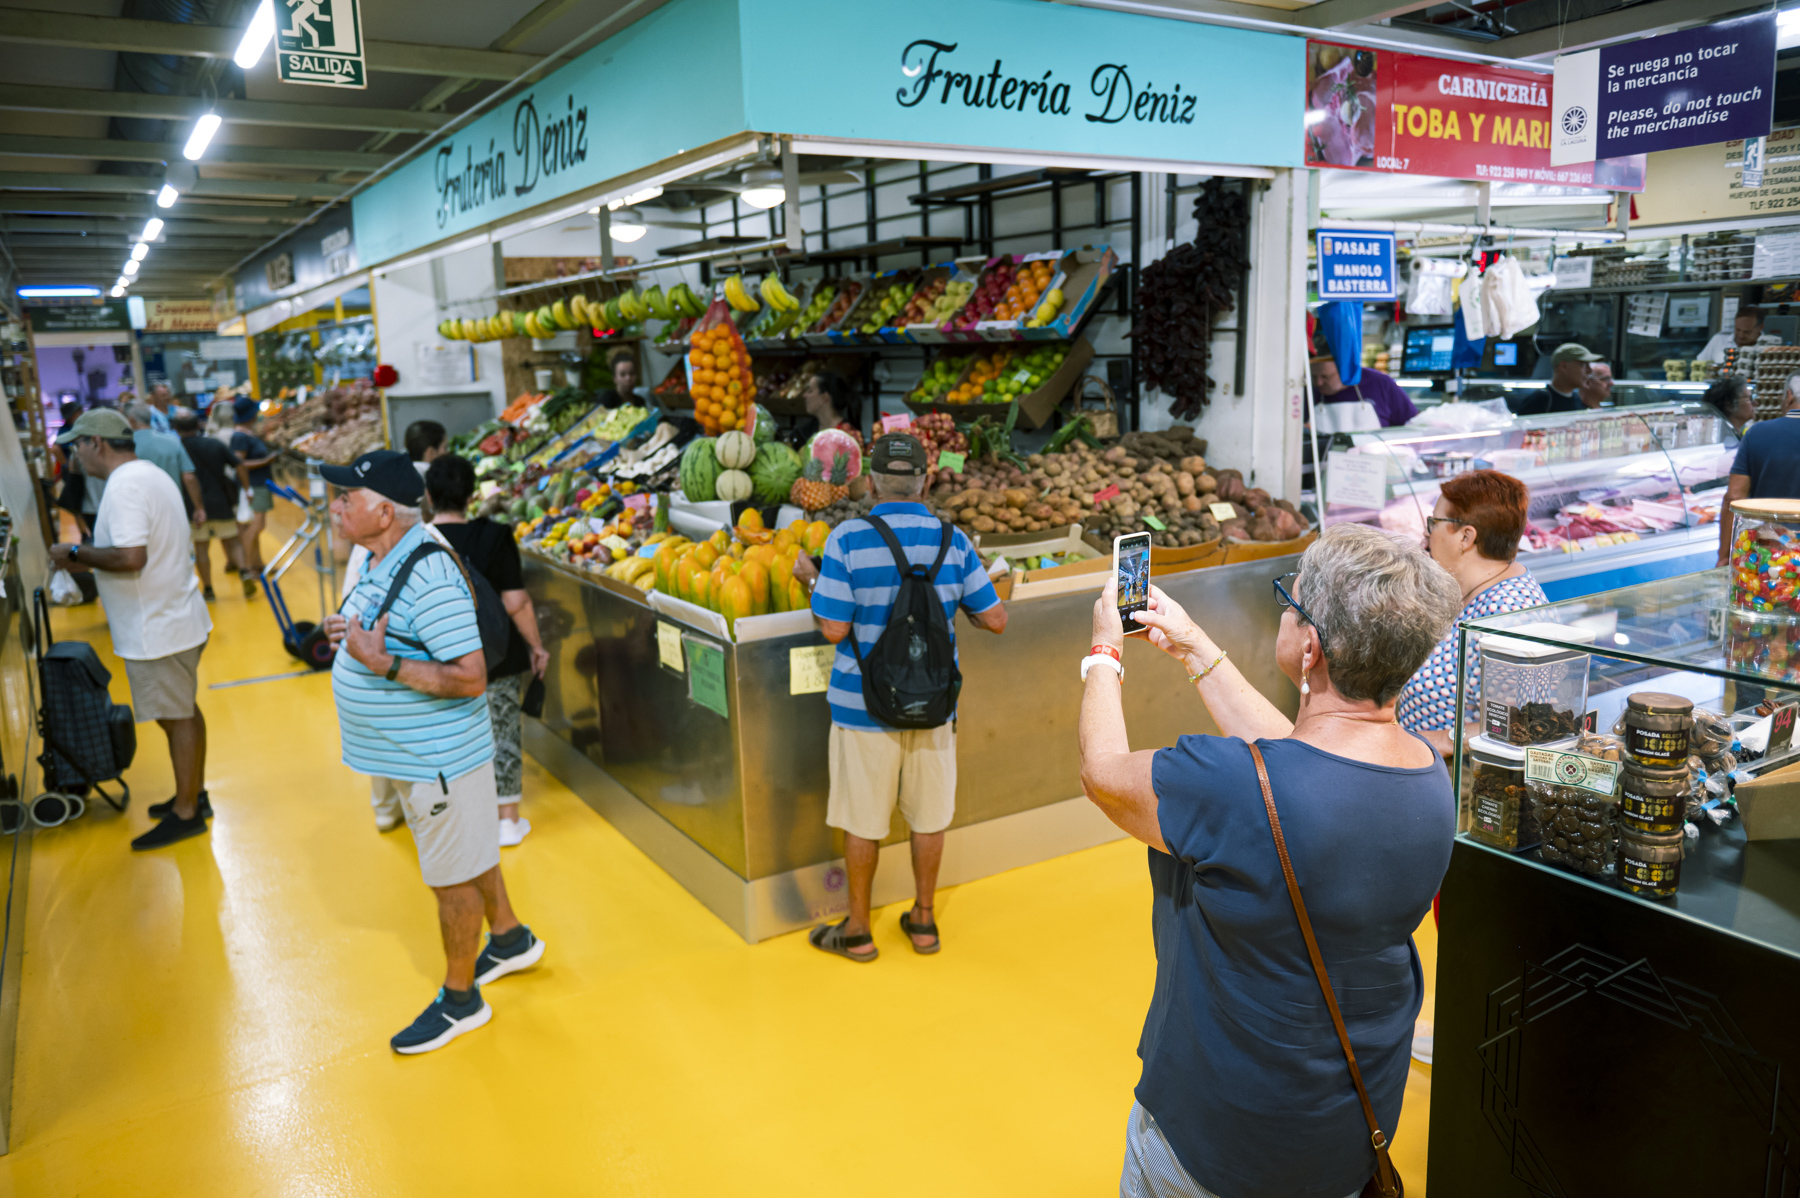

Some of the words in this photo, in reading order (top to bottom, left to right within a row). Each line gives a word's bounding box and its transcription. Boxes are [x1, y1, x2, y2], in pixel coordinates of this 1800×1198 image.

[289, 55, 355, 75] SALIDA
[1608, 65, 1625, 78] Se
[1629, 56, 1670, 74] ruega
[1674, 52, 1692, 65] no
[1698, 43, 1738, 60] tocar
[896, 39, 1070, 116] Frutería
[1085, 63, 1197, 125] Déniz
[1608, 80, 1620, 94] la
[1624, 65, 1698, 90] mercancía
[1438, 74, 1548, 107] CARNICERÍA
[1608, 107, 1658, 125] Please,
[1663, 102, 1681, 115] do
[1686, 96, 1712, 111] not
[1716, 86, 1762, 106] touch
[1394, 104, 1462, 140] TOBA
[1469, 112, 1486, 142] Y
[1491, 115, 1551, 149] MARI
[1607, 126, 1630, 140] the
[1634, 110, 1729, 136] merchandise
[435, 138, 507, 229] Frutería
[514, 93, 588, 196] Déniz
[1377, 156, 1402, 170] LOCAL:
[1403, 158, 1410, 170] 7
[1489, 165, 1502, 177] 922
[1529, 169, 1534, 179] Y
[1767, 199, 1784, 208] 922
[1334, 241, 1381, 256] PASAJE
[1333, 264, 1382, 277] MANOLO
[1328, 279, 1388, 292] BASTERRA
[1774, 708, 1792, 733] 94
[1492, 726, 1502, 734] 237
[1636, 729, 1660, 738] POSADA
[1624, 791, 1644, 802] POSADA
[1483, 823, 1494, 832] 248
[1624, 857, 1647, 868] POSADA
